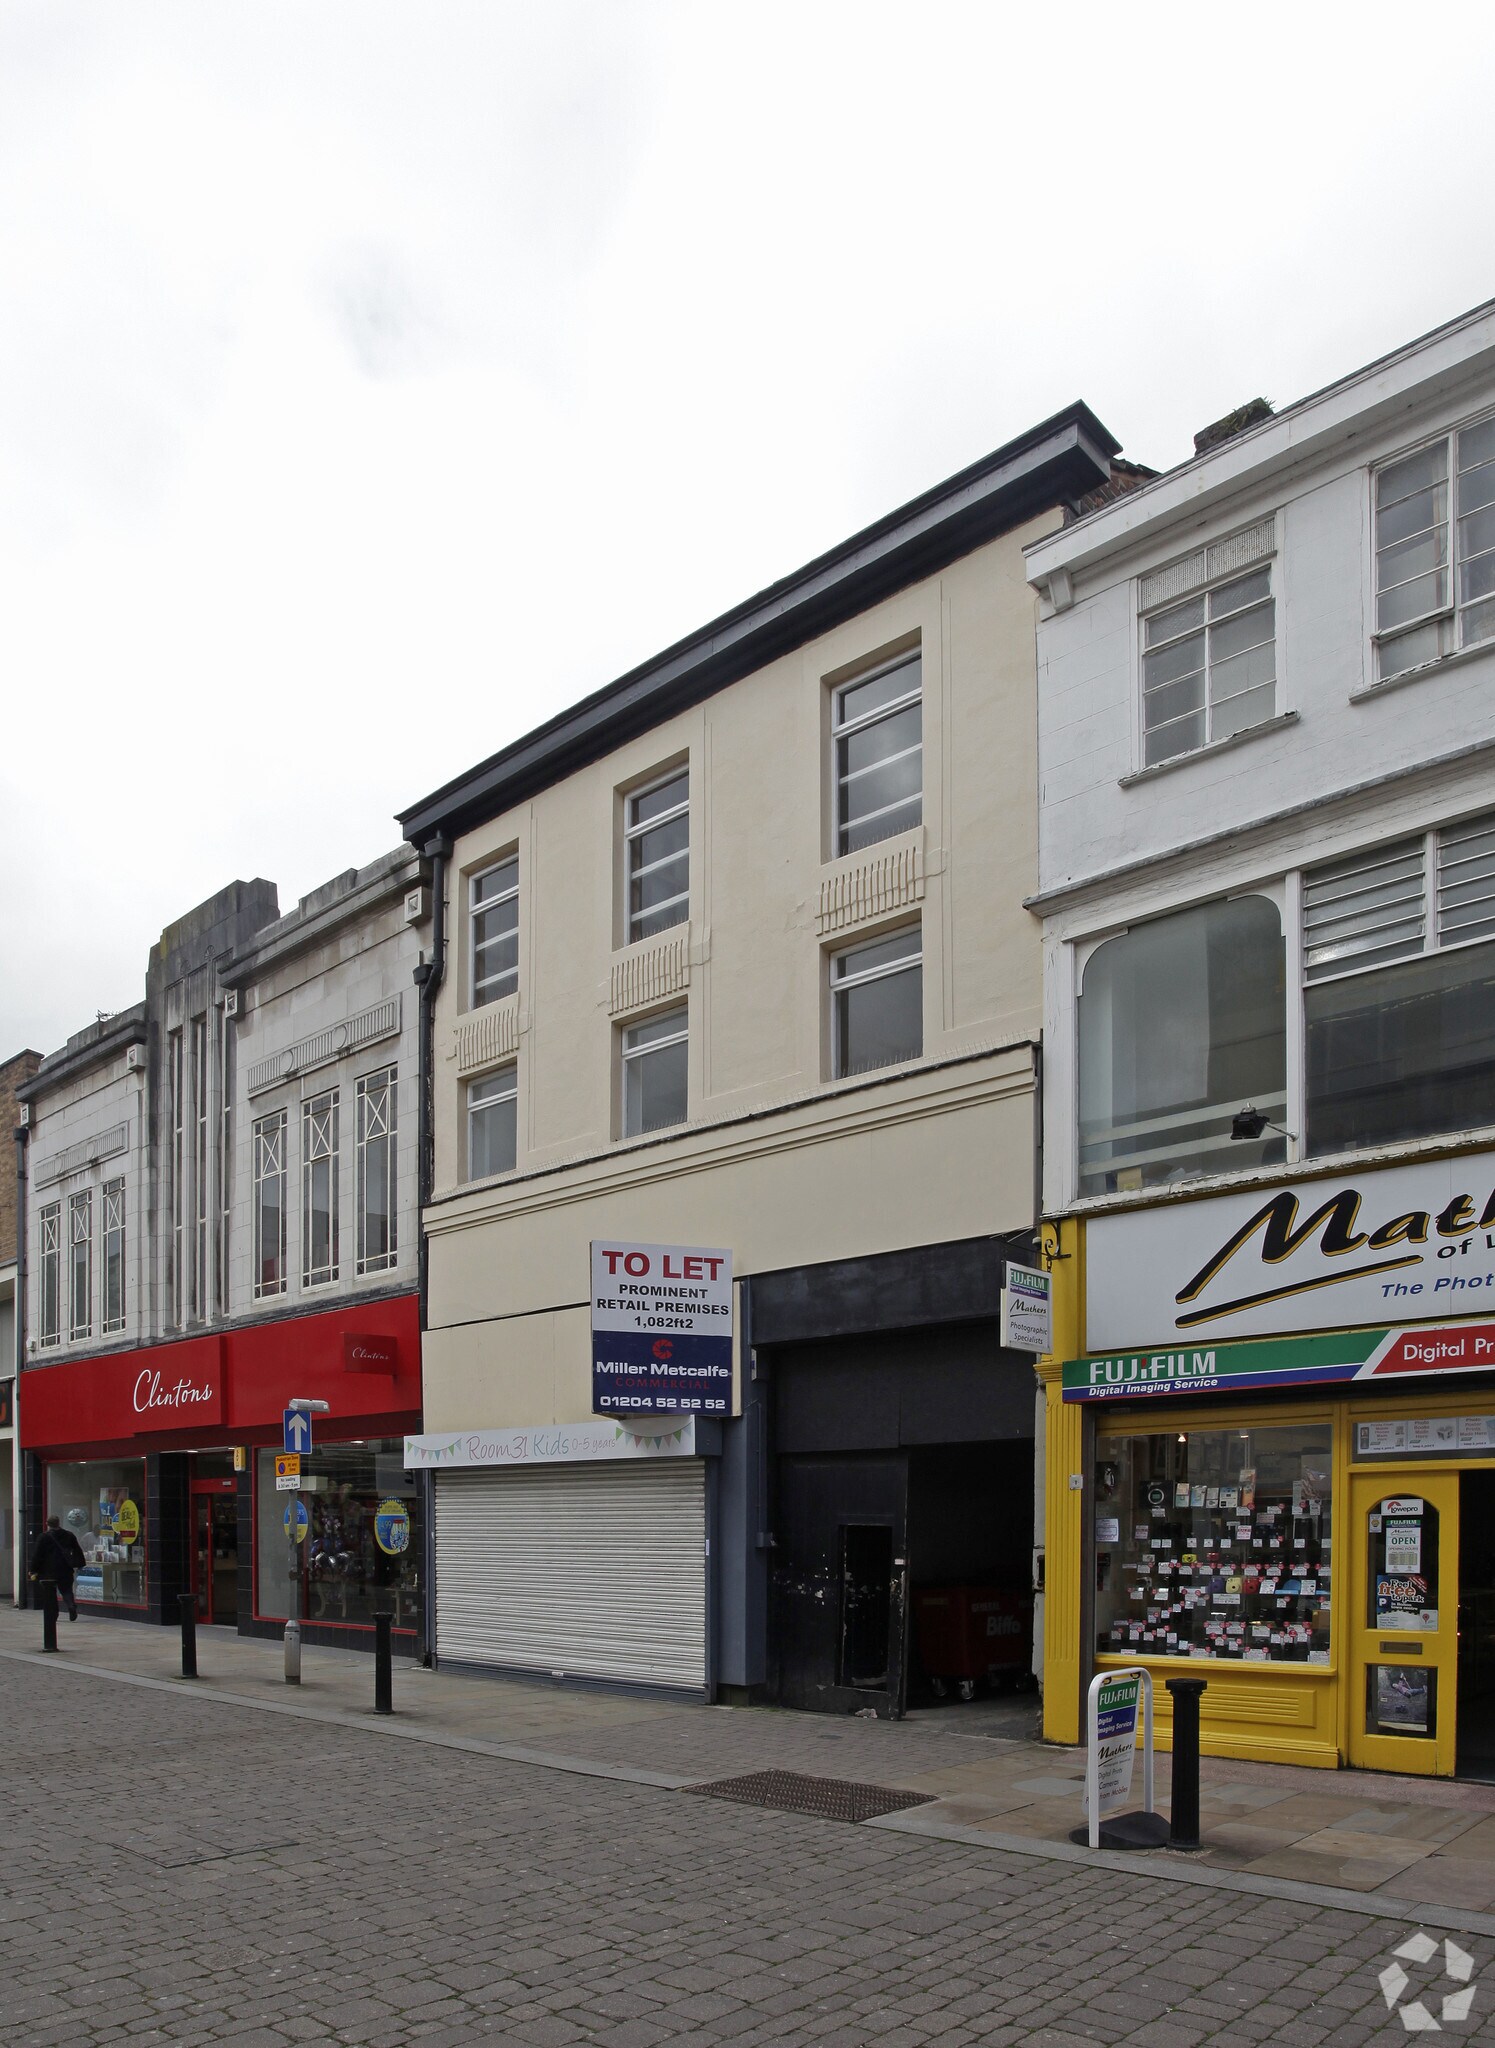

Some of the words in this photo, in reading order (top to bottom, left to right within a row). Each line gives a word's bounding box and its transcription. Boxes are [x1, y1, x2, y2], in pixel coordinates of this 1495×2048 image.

[1175, 1186, 1495, 1304] Mat
[1437, 1238, 1473, 1258] of
[602, 1250, 650, 1277] TO
[663, 1254, 724, 1281] LET
[619, 1284, 708, 1299] PROMINENT
[1381, 1283, 1424, 1297] The
[1434, 1273, 1495, 1292] Phot
[597, 1299, 650, 1311] RETAIL
[655, 1302, 729, 1315] PREMISES
[1010, 1299, 1047, 1314] Mathers
[634, 1316, 693, 1329] 1,082ft2
[1010, 1321, 1048, 1335] Photographic
[1014, 1333, 1043, 1344] Specialists
[352, 1346, 390, 1360] Clintons
[1404, 1338, 1465, 1363] Digital
[596, 1361, 648, 1375] Miller
[650, 1363, 729, 1377] Metcalfe
[133, 1369, 213, 1413] Clintons
[615, 1378, 710, 1389] COMMERCIAL
[1089, 1385, 1124, 1397] Digital
[1126, 1383, 1171, 1394] Imaging
[1174, 1379, 1218, 1389] Service
[600, 1396, 653, 1407] 01204
[656, 1398, 677, 1408] 52
[680, 1399, 701, 1409] 52
[704, 1400, 725, 1409] 52
[533, 1432, 569, 1456] Kids
[572, 1438, 590, 1450] 0-5
[592, 1438, 616, 1454] years
[1391, 1537, 1416, 1545] OPEN
[1378, 1582, 1416, 1597] free
[1391, 1579, 1413, 1589] Feel
[1379, 1598, 1387, 1606] P
[1402, 1595, 1424, 1603] park
[1098, 1716, 1113, 1726] Digital
[1116, 1721, 1132, 1730] Service
[1098, 1744, 1132, 1760] Mathers
[1099, 1780, 1119, 1790] Cameras
